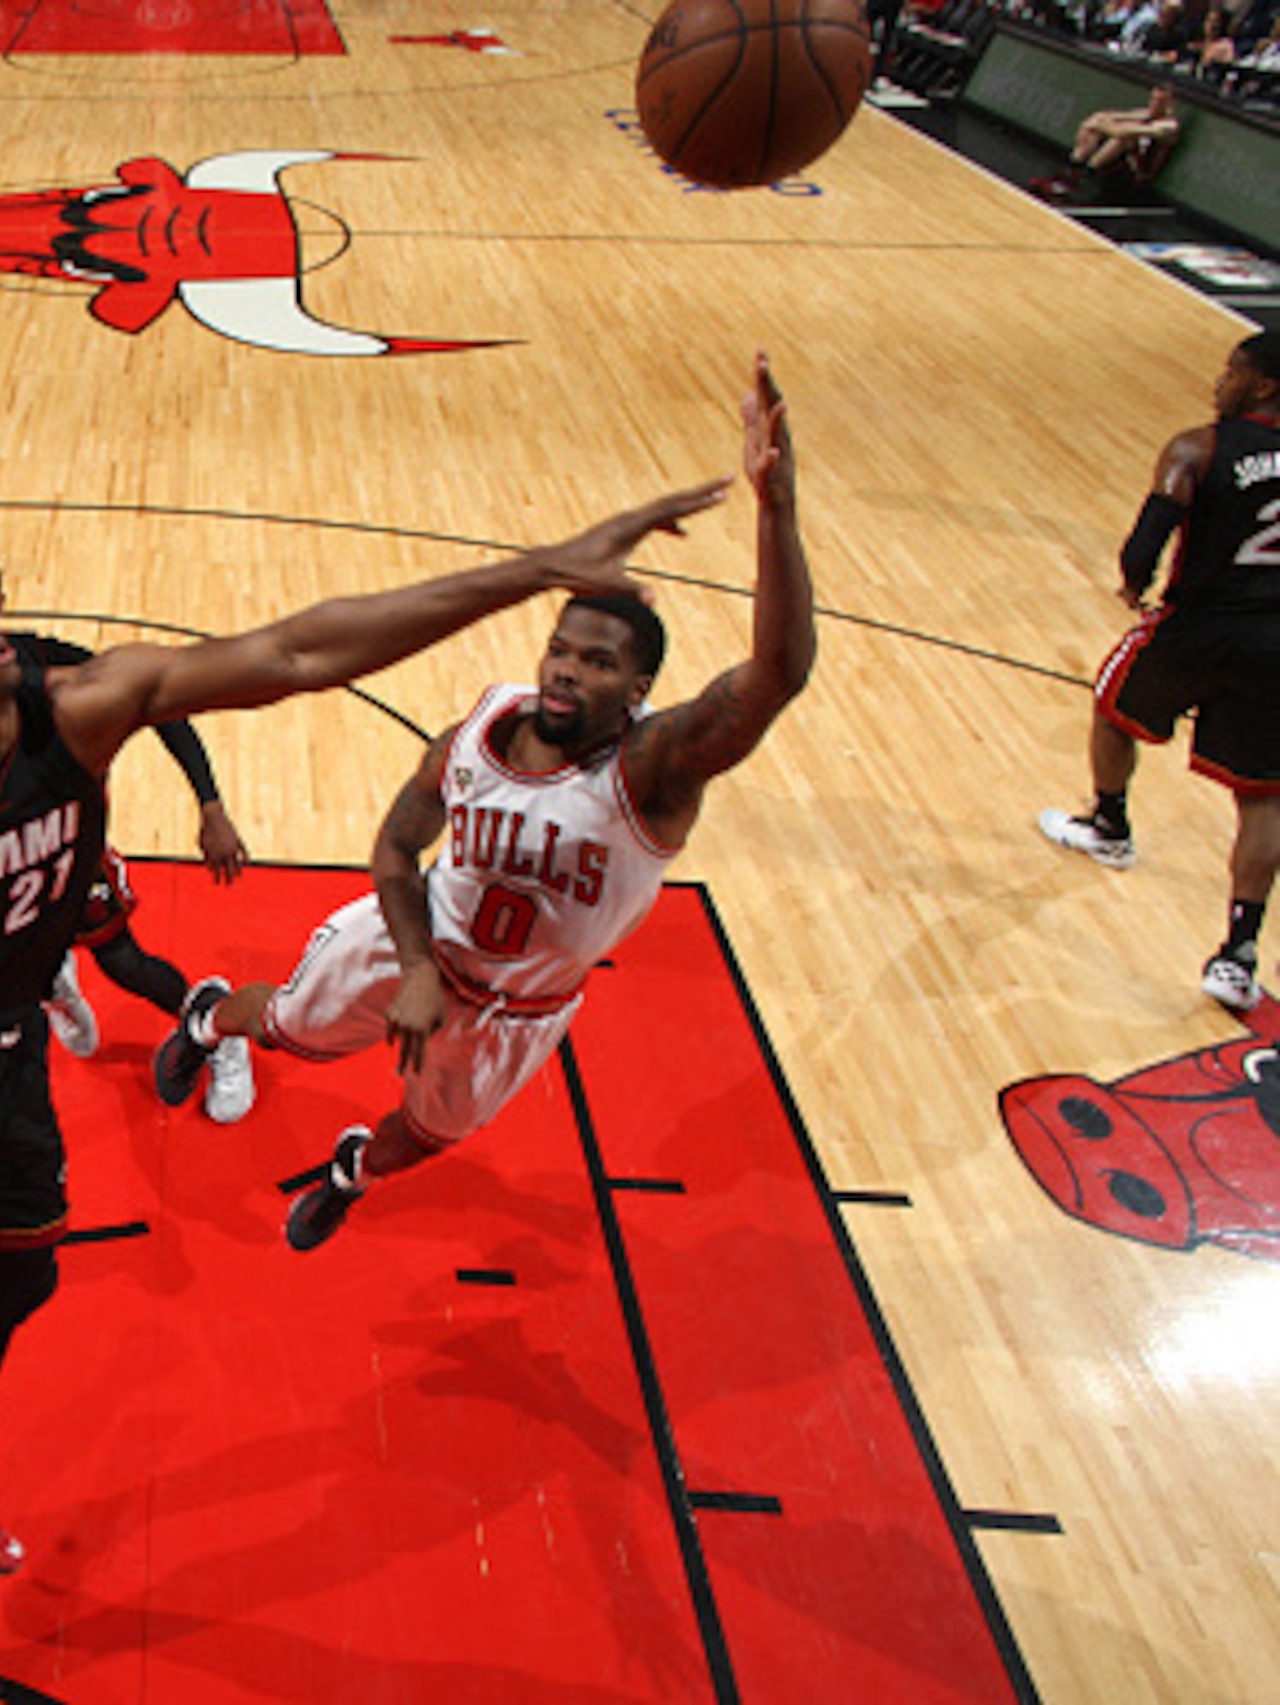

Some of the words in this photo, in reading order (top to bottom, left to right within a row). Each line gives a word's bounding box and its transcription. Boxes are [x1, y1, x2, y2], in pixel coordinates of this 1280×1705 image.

[4, 849, 74, 935] 21
[451, 803, 608, 906] BULLS
[472, 883, 538, 955] 0
